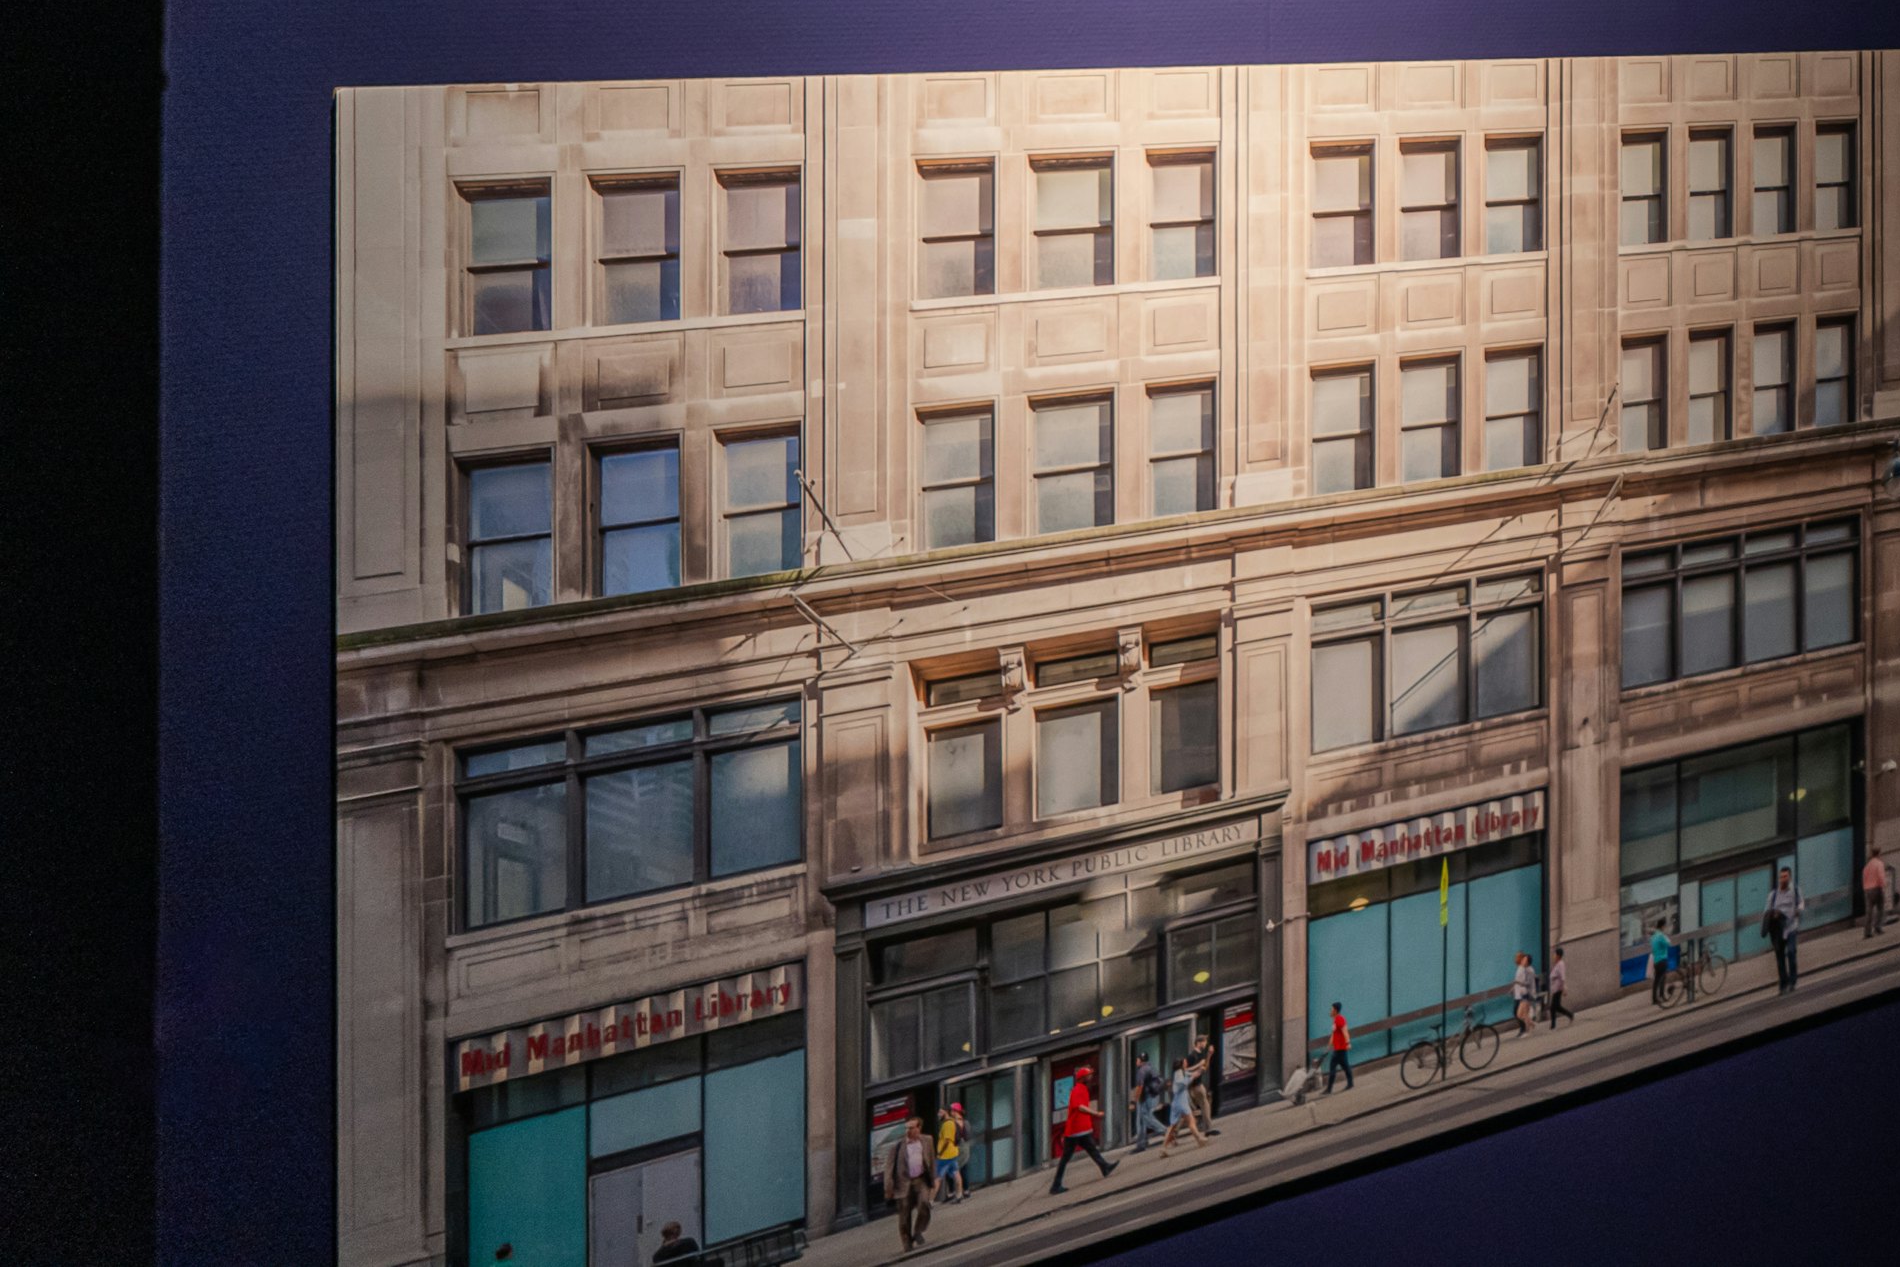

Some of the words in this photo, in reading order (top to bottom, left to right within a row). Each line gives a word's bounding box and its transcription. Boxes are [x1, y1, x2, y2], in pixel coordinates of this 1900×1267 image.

[881, 897, 929, 920] THE
[941, 881, 992, 906] NEW
[1002, 864, 1060, 892] YORK
[1072, 846, 1148, 877] PUBLIC
[1161, 825, 1245, 857] LIBRARY
[1317, 848, 1349, 874] Mid
[1361, 823, 1466, 861] Manhattan
[1474, 805, 1540, 836] Library
[461, 1042, 510, 1077] Mid
[527, 1007, 683, 1062] Manhattan
[695, 980, 791, 1022] Library
